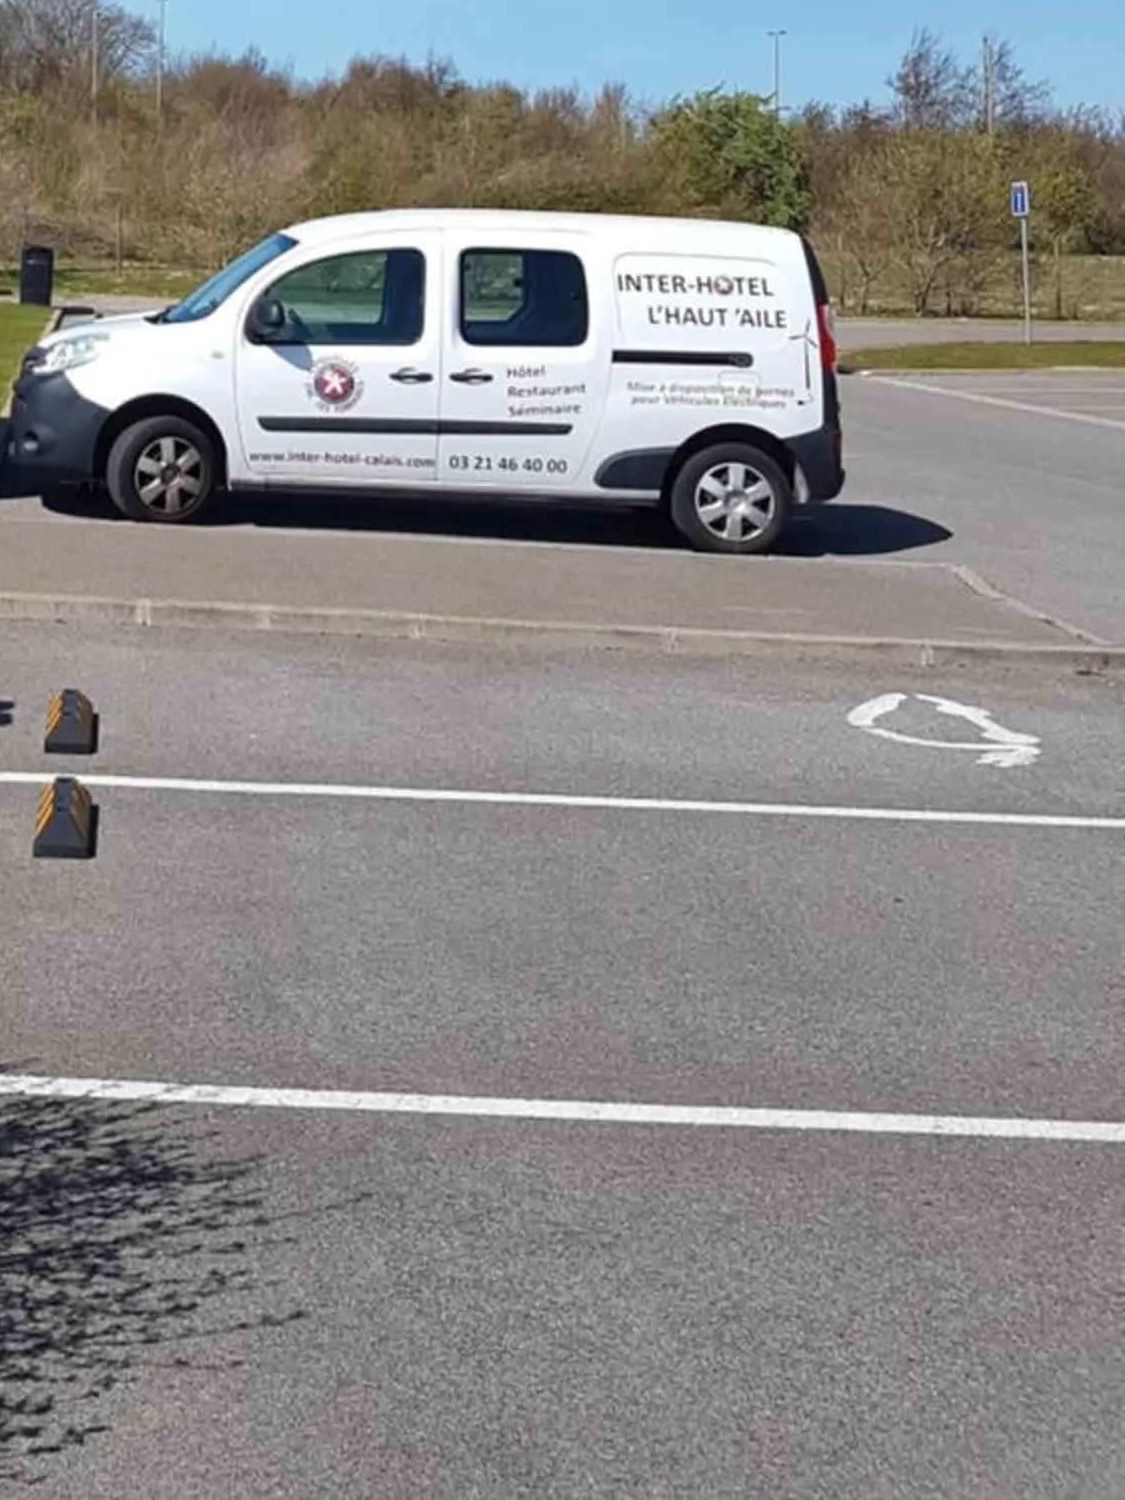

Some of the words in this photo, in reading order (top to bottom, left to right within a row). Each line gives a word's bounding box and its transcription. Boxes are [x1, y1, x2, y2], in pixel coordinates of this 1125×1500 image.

[617, 274, 774, 296] INTER-HOTEL
[648, 305, 728, 327] L'HAUT
[508, 383, 586, 397] Restaurant
[508, 402, 582, 416] Séminaire
[249, 450, 436, 468] www.inter-hotel-calais.com
[448, 454, 469, 469] 03
[474, 456, 492, 470] 21
[498, 457, 519, 471] 46
[522, 458, 543, 472] 40
[546, 458, 568, 474] 00
